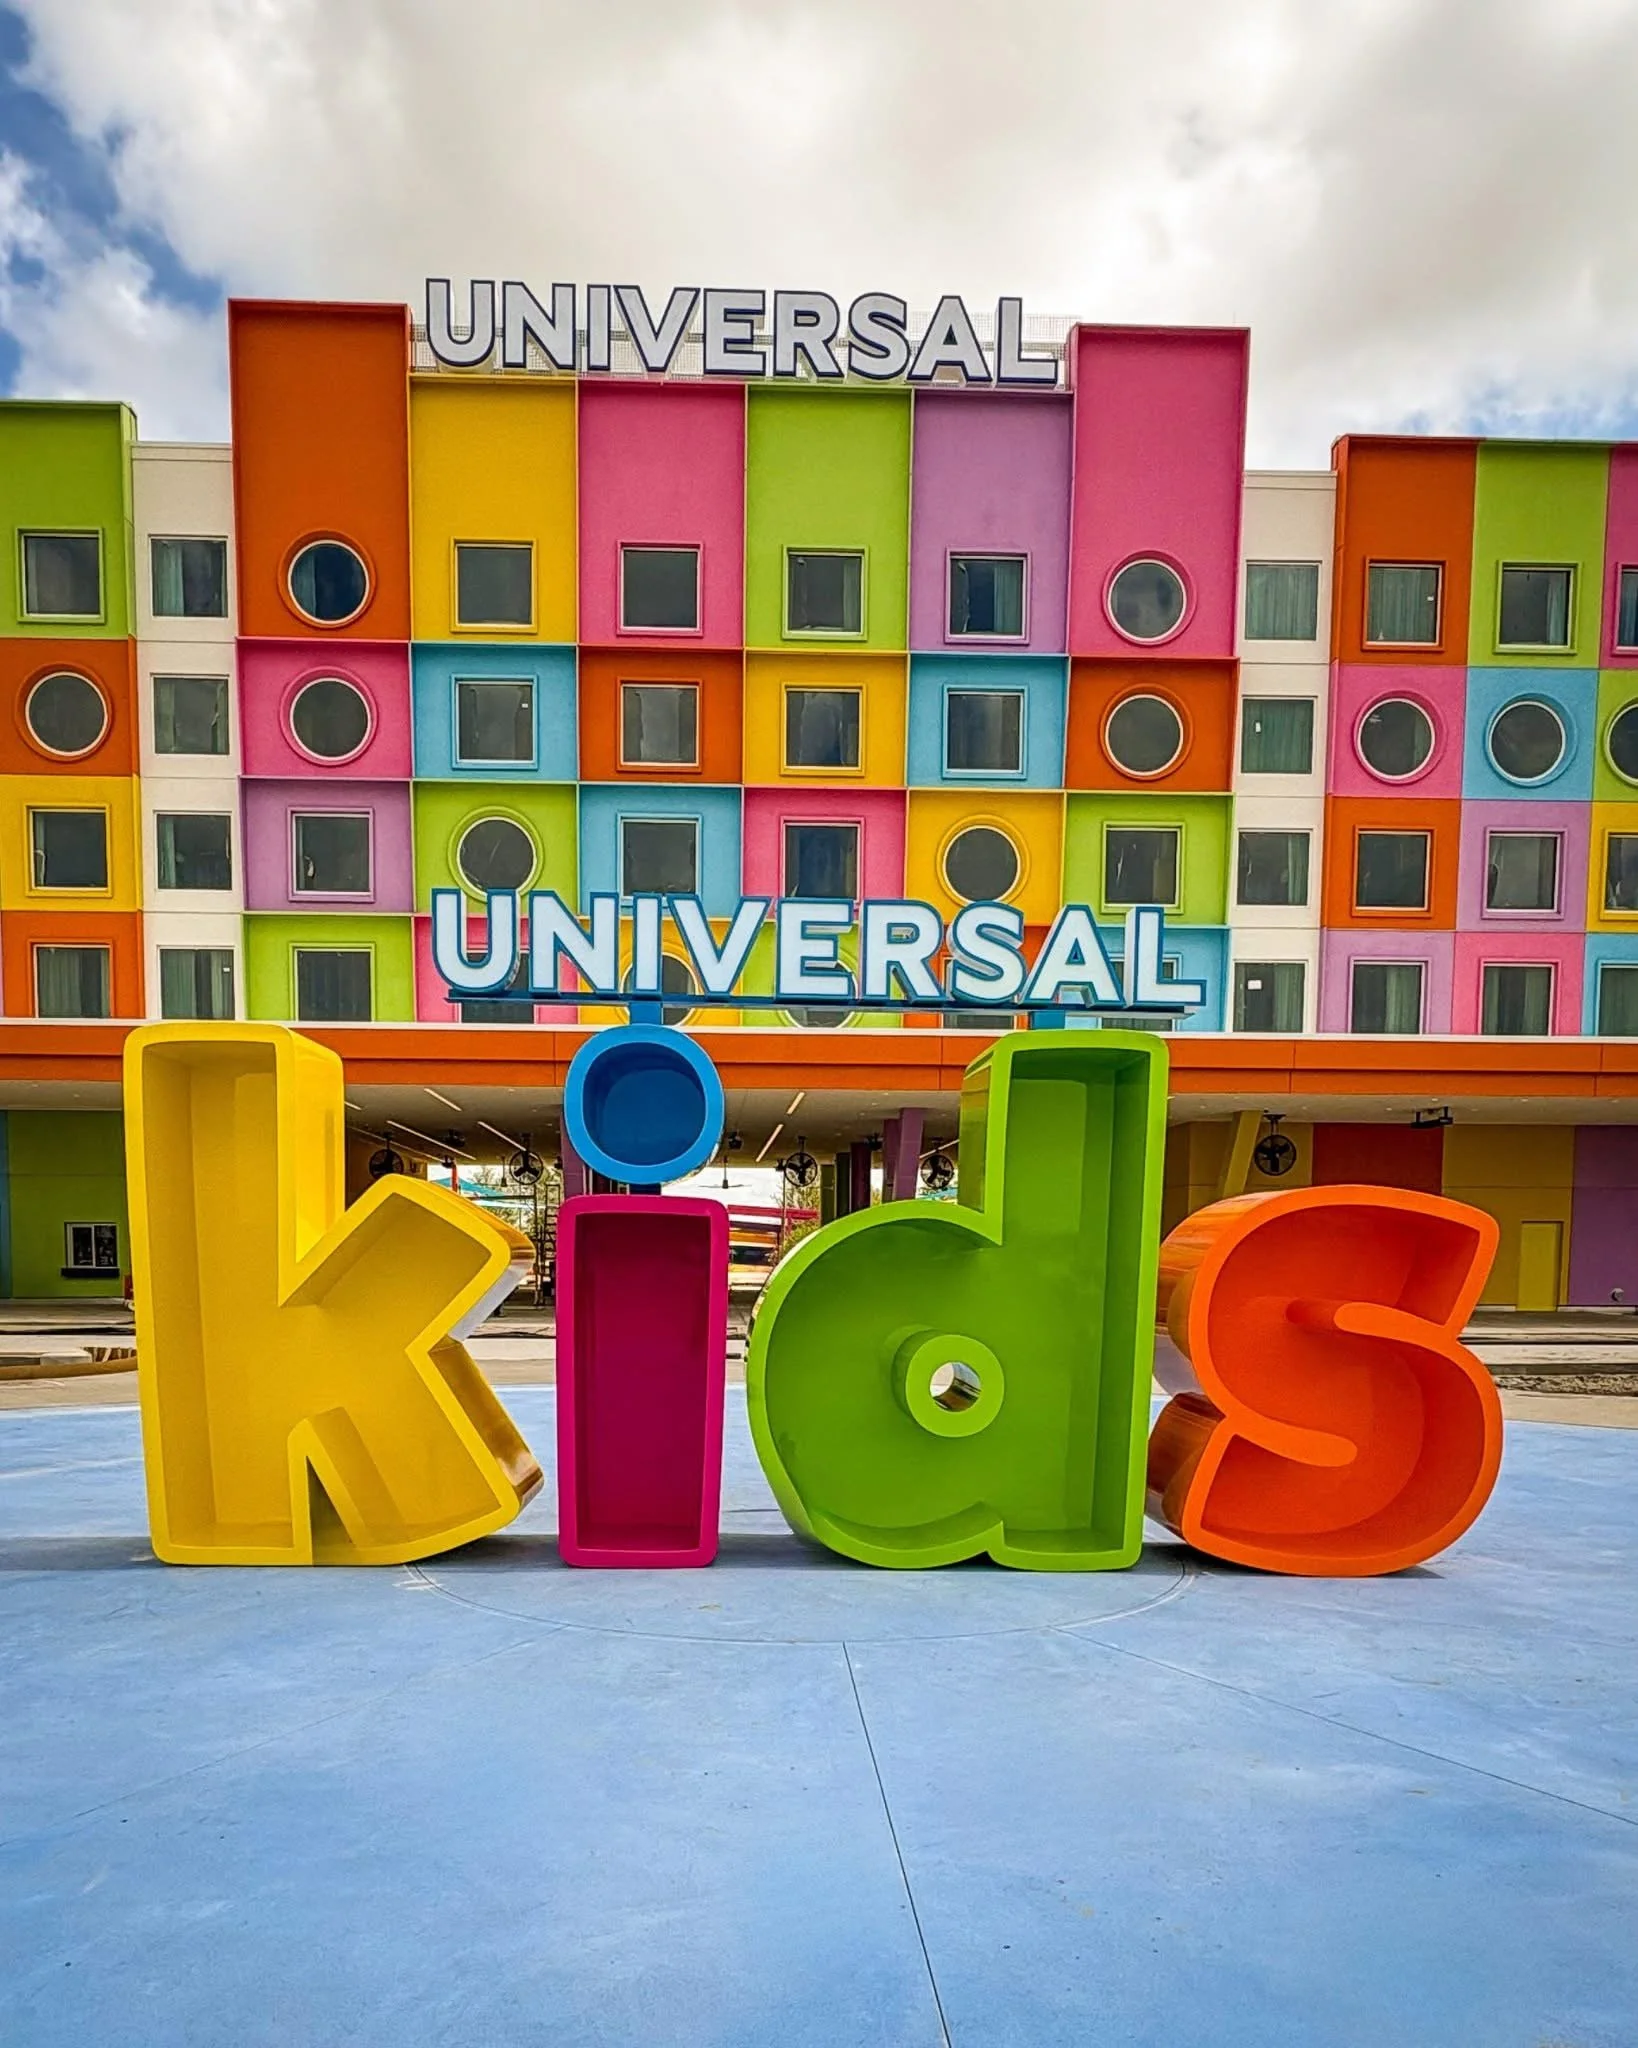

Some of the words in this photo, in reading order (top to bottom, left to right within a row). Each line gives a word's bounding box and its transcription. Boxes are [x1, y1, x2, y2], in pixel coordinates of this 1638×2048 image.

[426, 278, 1059, 384] UNIVERSAL
[432, 888, 1206, 1008] UNIVERSAL
[123, 1022, 1503, 1577] kids
